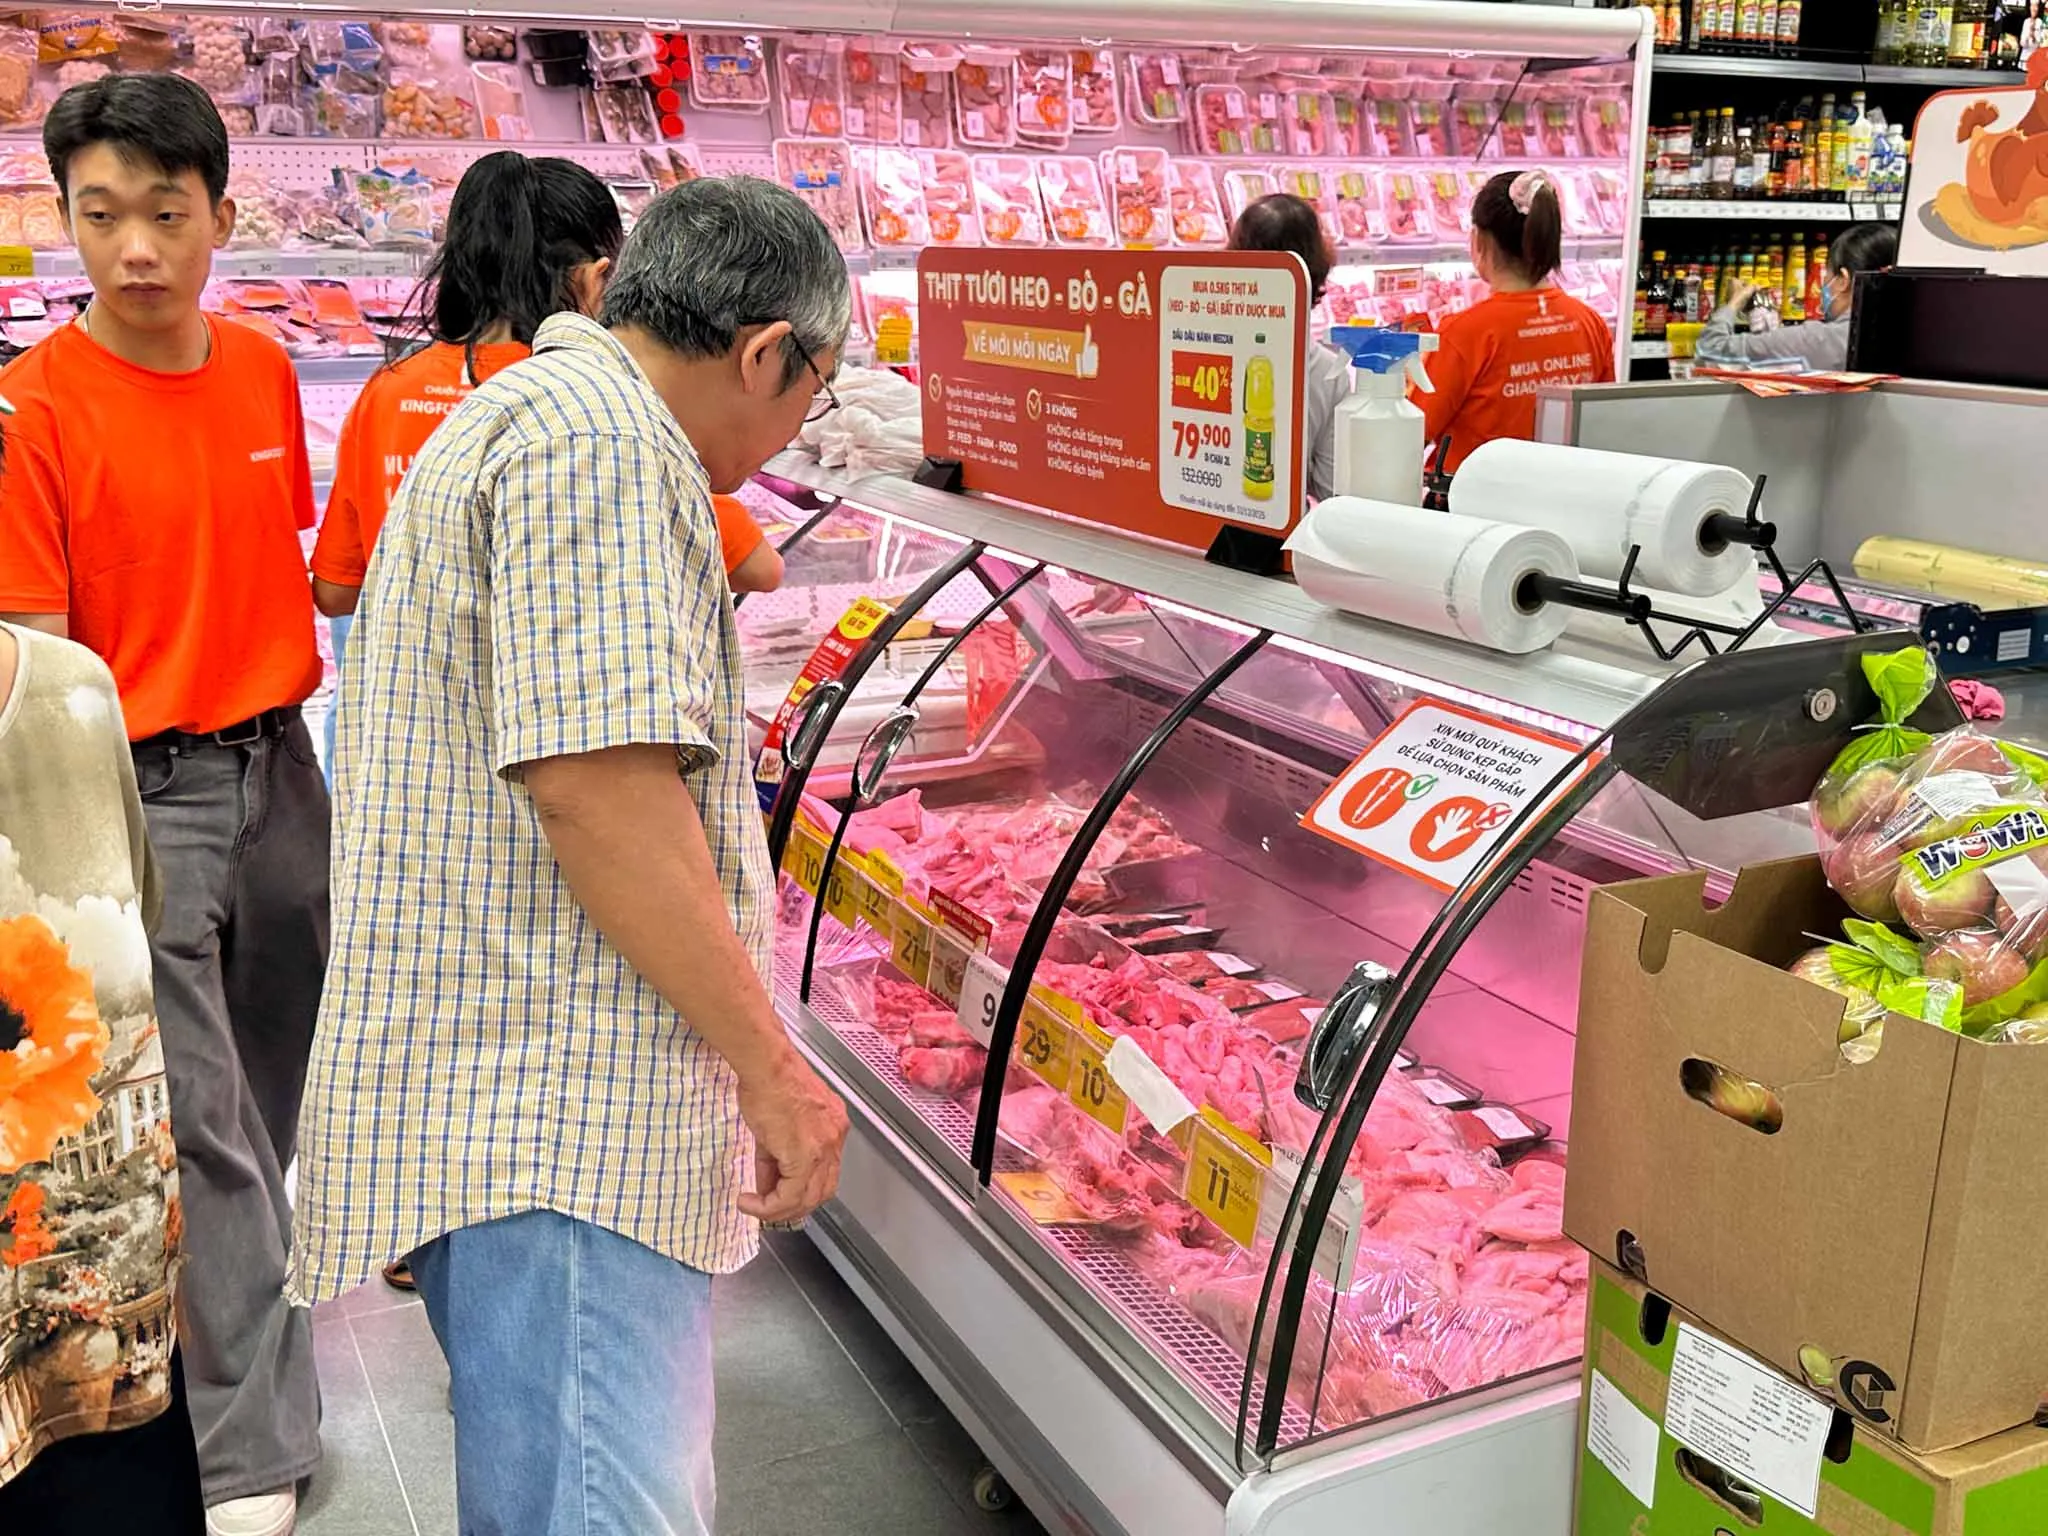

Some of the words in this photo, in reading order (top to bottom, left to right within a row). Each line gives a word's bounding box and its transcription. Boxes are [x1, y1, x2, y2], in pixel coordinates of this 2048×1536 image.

[924, 271, 962, 309] THỊT
[963, 269, 1006, 305] TƯƠI
[1010, 275, 1050, 309] HEO
[1067, 269, 1098, 312] BÒ
[1119, 270, 1152, 316] GÀ
[1192, 281, 1208, 294] MUA
[1269, 304, 1286, 319] MUA
[1038, 337, 1071, 364] NGÀY
[1510, 361, 1540, 377] MUA
[1543, 353, 1592, 372] ONLINE
[1193, 365, 1229, 401] 40%
[1172, 420, 1231, 460] 79.900
[1435, 723, 1455, 737] XIN
[1452, 728, 1477, 745] MỜI
[1475, 738, 1504, 752] QUÝ
[1498, 745, 1543, 767] KHÁCH
[1442, 743, 1475, 761] DỤNG
[1472, 755, 1497, 769] KẸP
[1433, 758, 1466, 775] CHỌN
[1464, 769, 1491, 785] SẢN
[1488, 779, 1527, 798] PHẨM
[982, 993, 996, 1028] 9
[1081, 1059, 1106, 1106] 10
